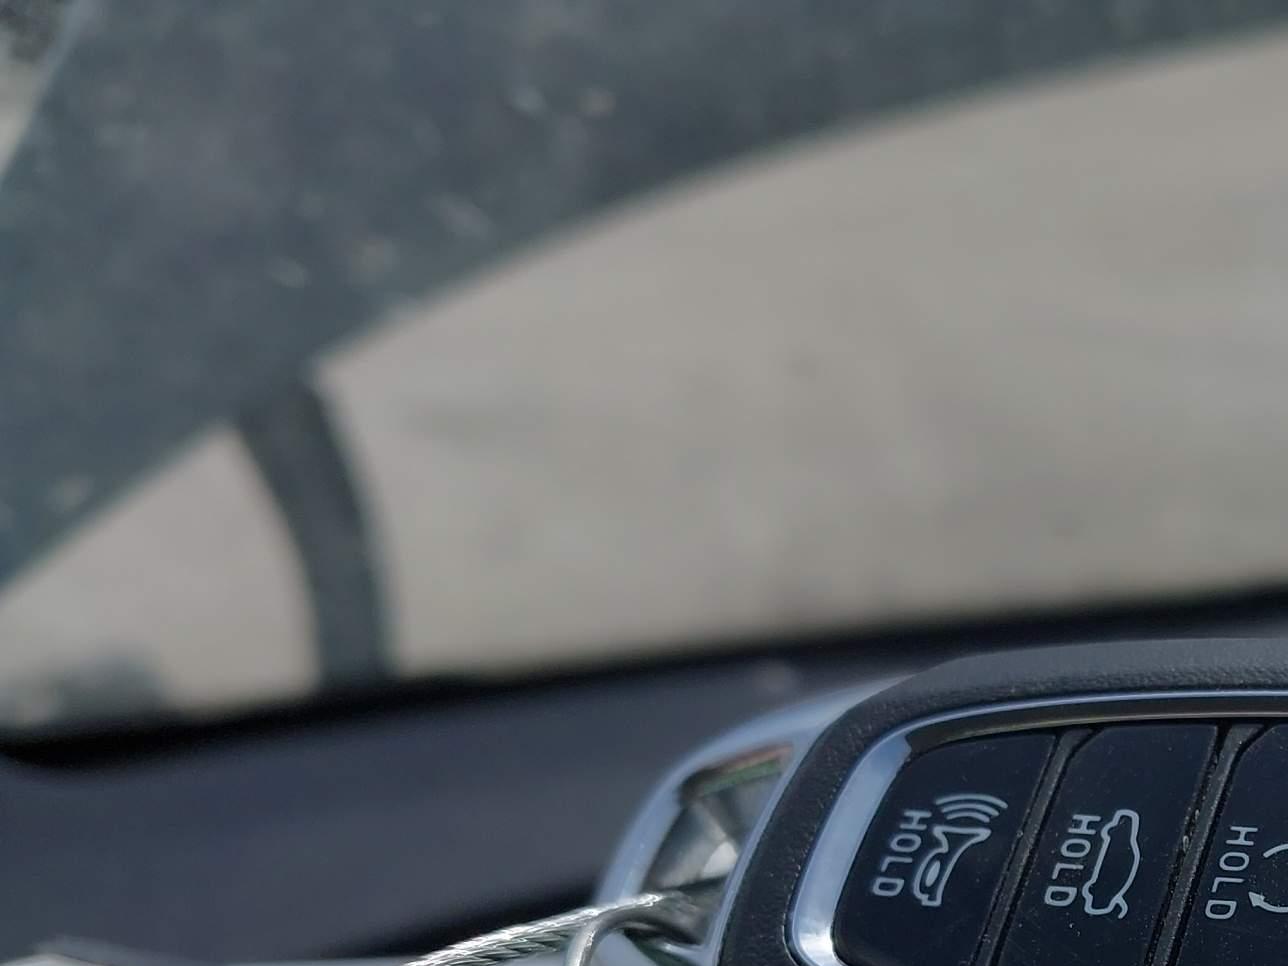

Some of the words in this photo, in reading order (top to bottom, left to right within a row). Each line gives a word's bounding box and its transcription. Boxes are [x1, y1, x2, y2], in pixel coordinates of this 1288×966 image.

[872, 808, 932, 898] HOLD
[1044, 814, 1101, 907] HOLD
[1205, 825, 1258, 919] HOLD
